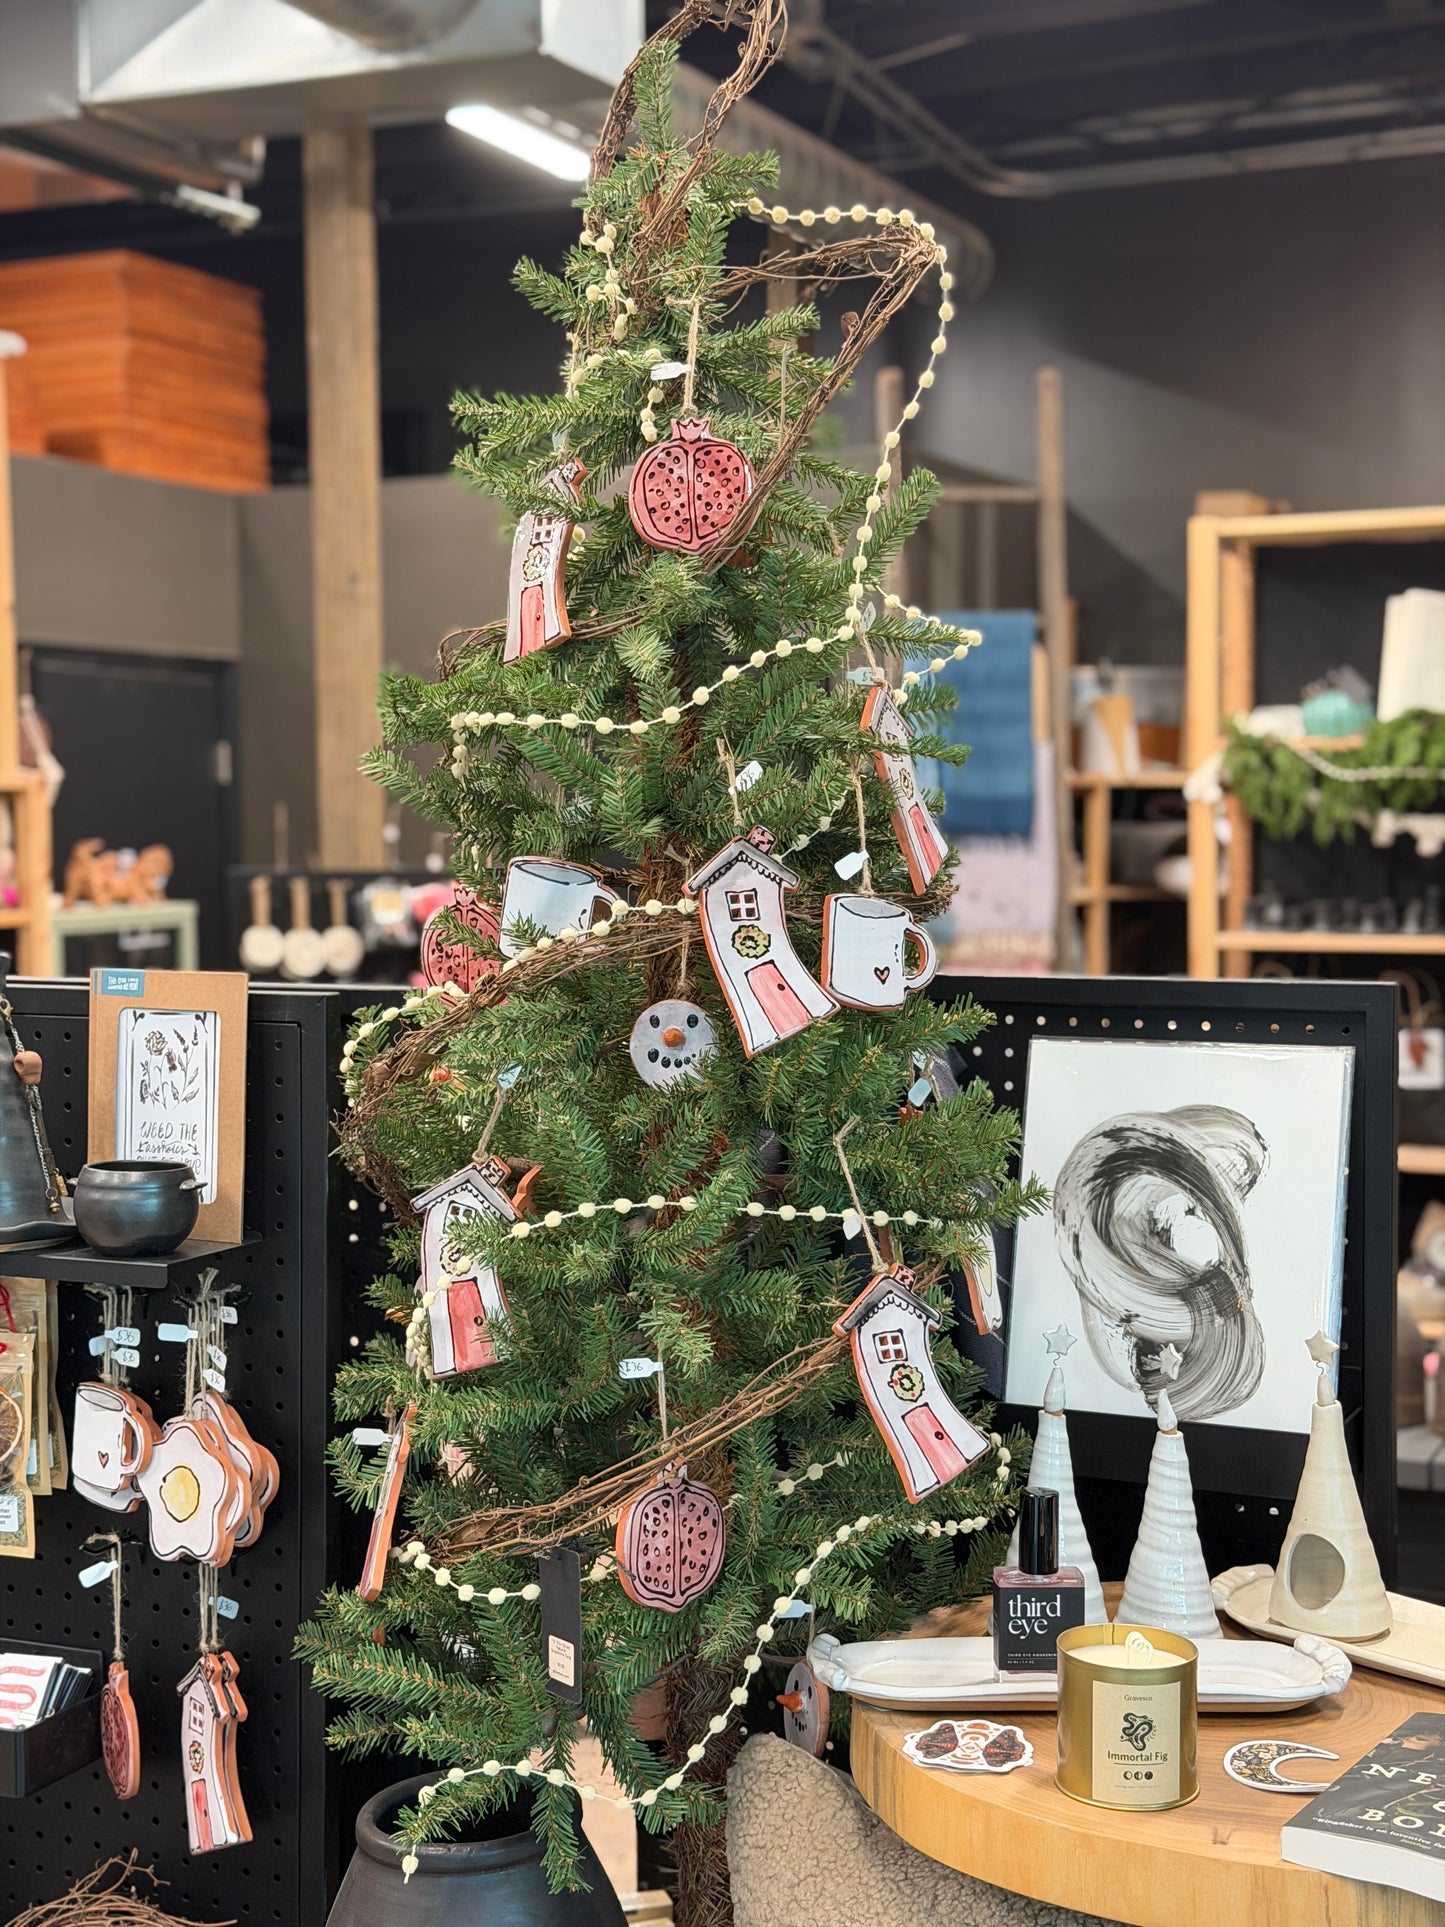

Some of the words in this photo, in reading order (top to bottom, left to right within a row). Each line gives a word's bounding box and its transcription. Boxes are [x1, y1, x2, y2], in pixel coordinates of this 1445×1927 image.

[140, 1121, 174, 1139] WEED
[180, 1123, 198, 1141] THE
[116, 1329, 135, 1343] $36
[1008, 1594, 1061, 1617] third
[1008, 1619, 1048, 1640] eye
[1124, 1694, 1153, 1702] Gravesco
[1107, 1750, 1153, 1762] Immortal
[1154, 1752, 1168, 1762] Fig
